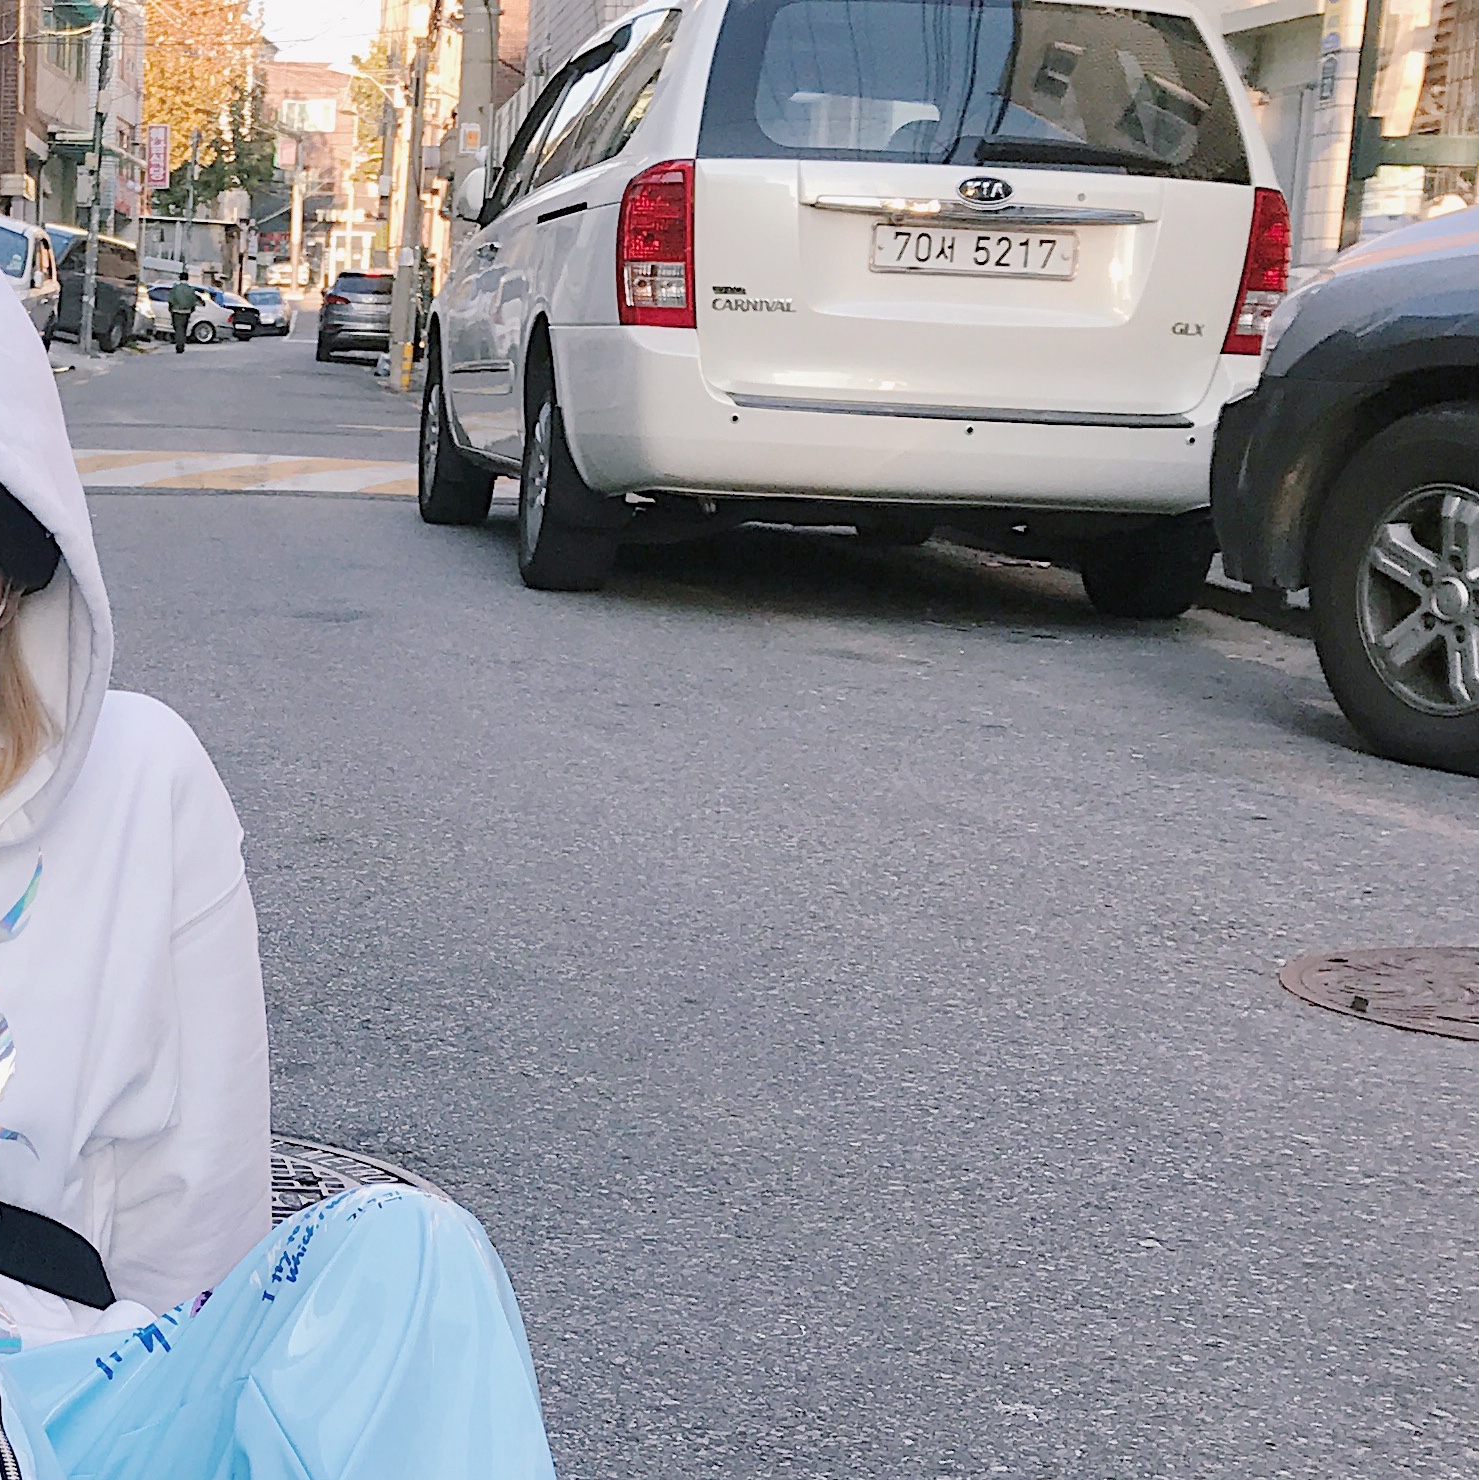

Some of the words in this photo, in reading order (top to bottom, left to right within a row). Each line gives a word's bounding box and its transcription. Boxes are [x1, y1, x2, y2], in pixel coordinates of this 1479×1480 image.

[966, 181, 1005, 198] KIA
[893, 231, 955, 263] 70서
[973, 235, 1057, 269] 5217
[712, 298, 797, 313] CARNIVAL
[1171, 322, 1206, 337] GLX
